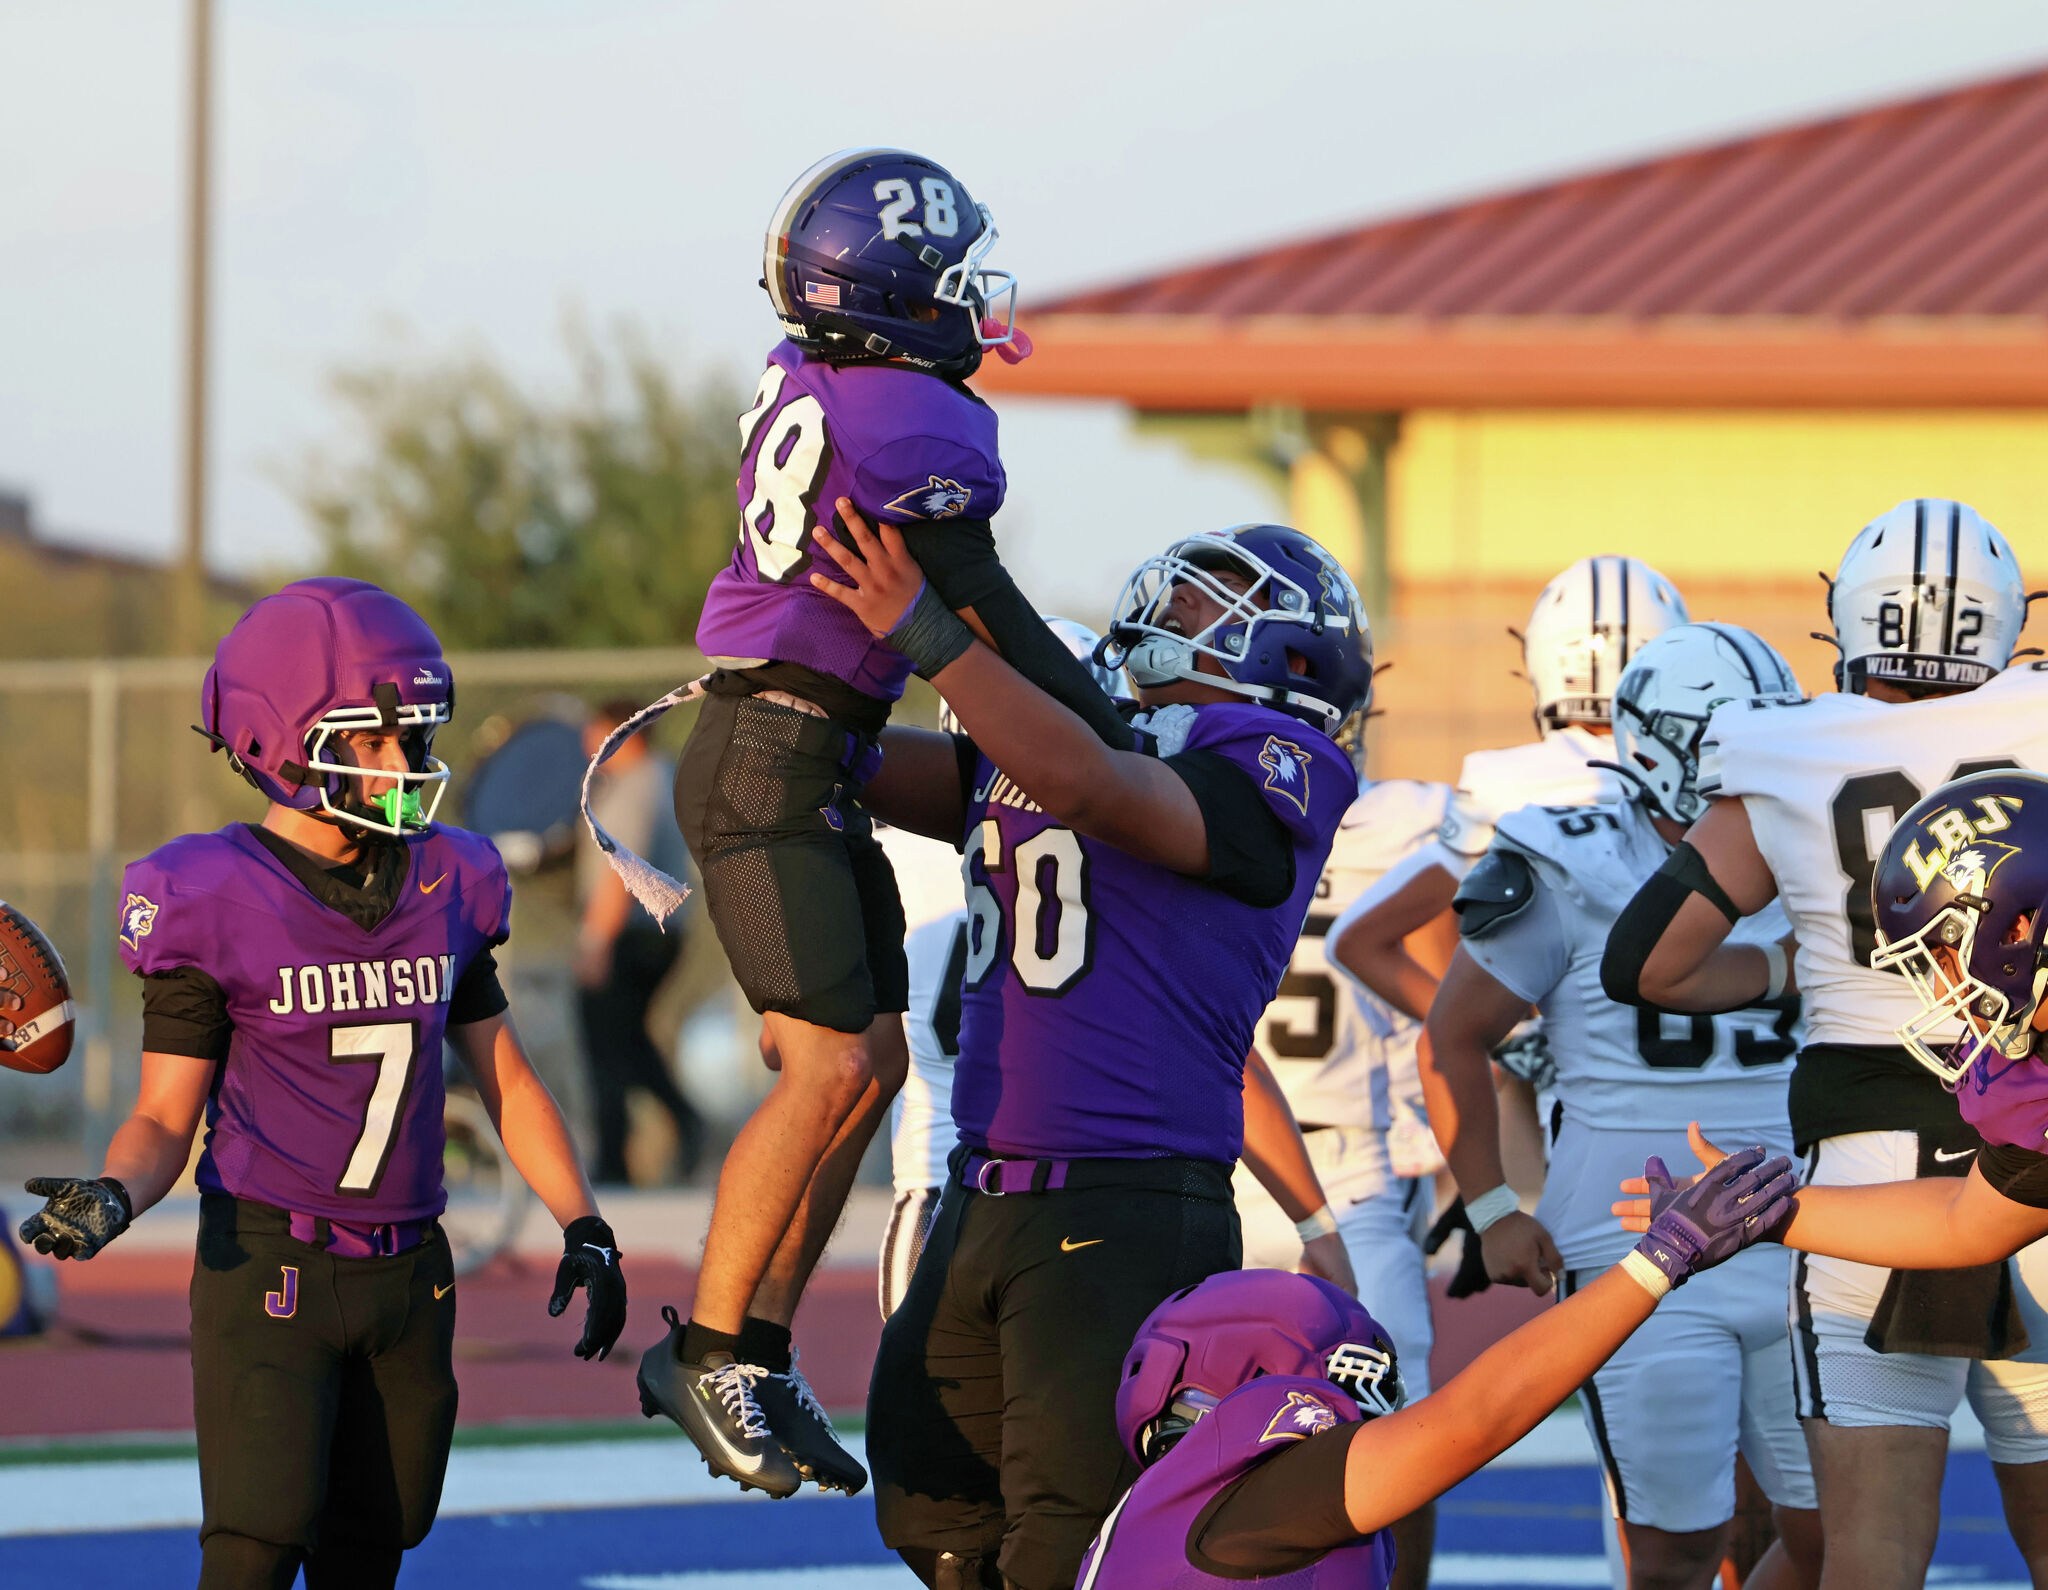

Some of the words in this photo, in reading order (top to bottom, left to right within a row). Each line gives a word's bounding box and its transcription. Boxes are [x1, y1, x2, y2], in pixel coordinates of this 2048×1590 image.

[873, 177, 959, 241] 28
[1879, 602, 1903, 648] 8
[1954, 609, 1983, 656] 2
[413, 676, 442, 686] GUARDIAN
[1866, 657, 1907, 677] WILL
[1914, 660, 1939, 679] TO
[1902, 794, 2012, 894] LBJ
[963, 819, 1096, 998] 60
[269, 954, 457, 1016] JOHNSON
[328, 1020, 419, 1197] 7
[264, 1265, 298, 1318] J
